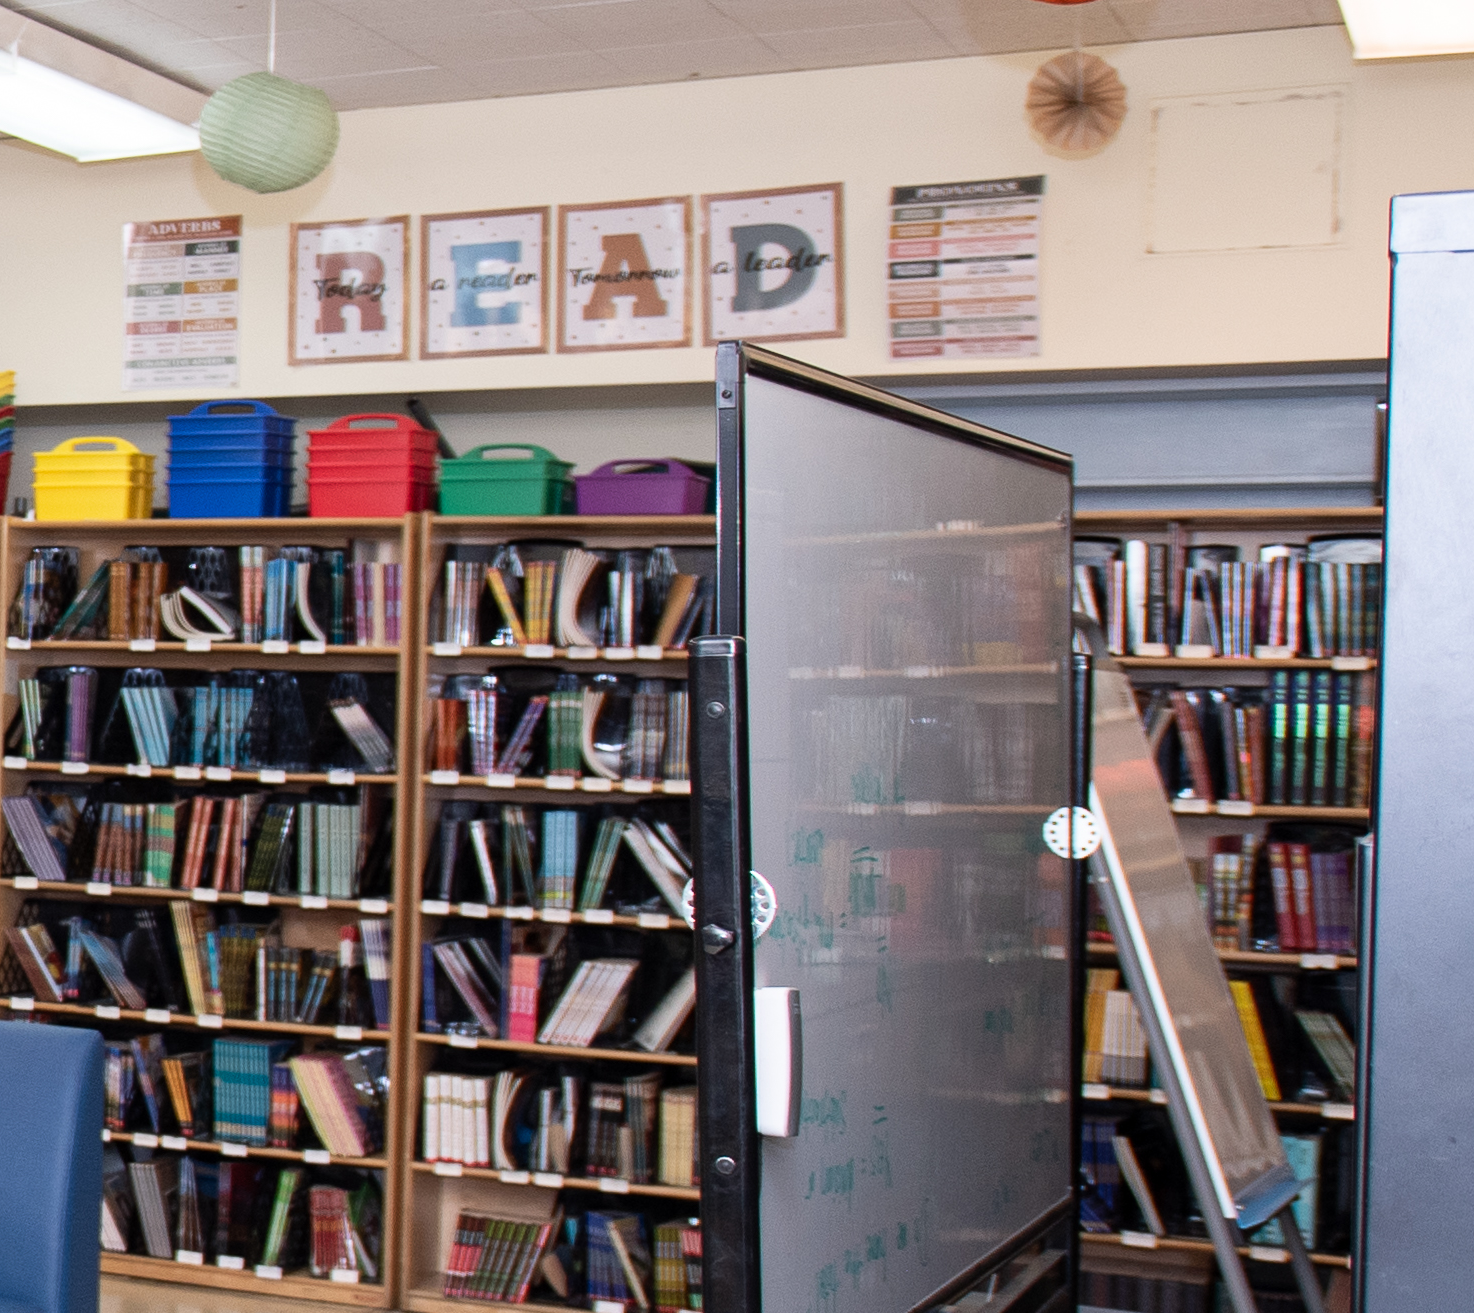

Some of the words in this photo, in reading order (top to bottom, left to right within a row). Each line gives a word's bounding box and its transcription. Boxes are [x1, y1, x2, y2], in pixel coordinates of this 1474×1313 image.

[148, 220, 222, 235] ADVERBS
[743, 247, 834, 273] leader
[458, 267, 539, 289] reader
[569, 267, 681, 287] Tomorrow
[314, 277, 387, 302] Today
